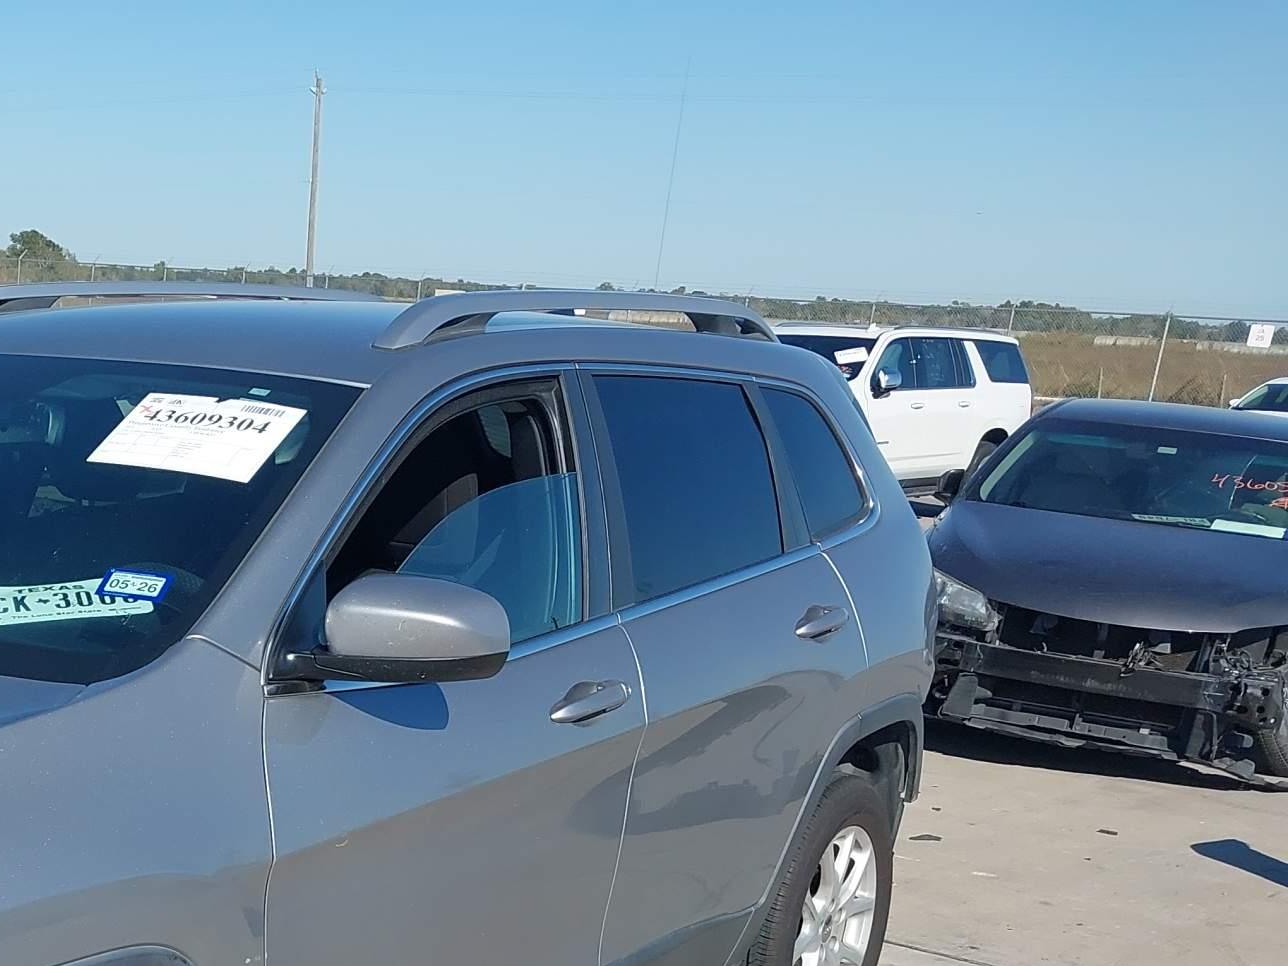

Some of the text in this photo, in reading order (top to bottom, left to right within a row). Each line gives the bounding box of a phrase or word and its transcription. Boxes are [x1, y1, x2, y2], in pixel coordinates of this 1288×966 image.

[143, 408, 272, 434] 43609304
[13, 584, 85, 594] TEXAS
[109, 579, 159, 593] 05 26
